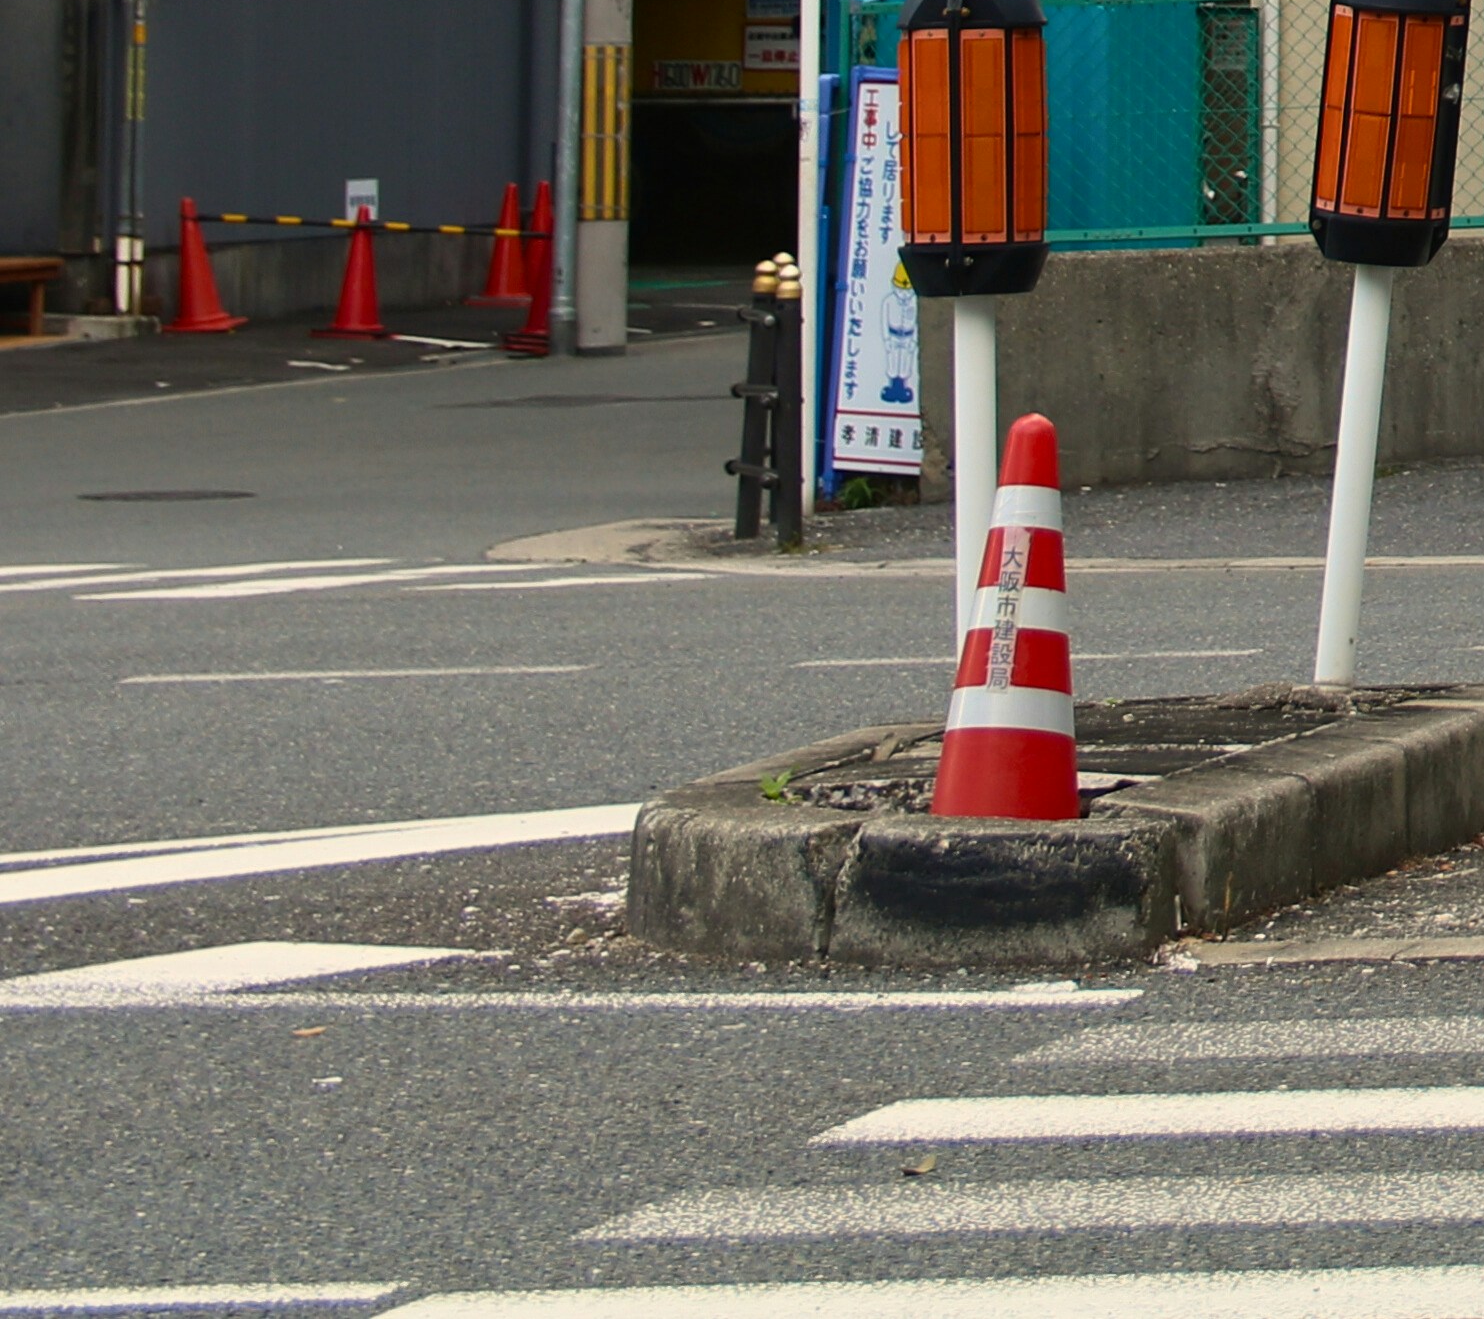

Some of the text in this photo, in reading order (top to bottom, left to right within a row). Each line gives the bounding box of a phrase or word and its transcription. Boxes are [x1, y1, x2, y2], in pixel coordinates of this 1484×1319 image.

[861, 89, 880, 150] 工事中
[988, 546, 1024, 691] 大阪市建設局
